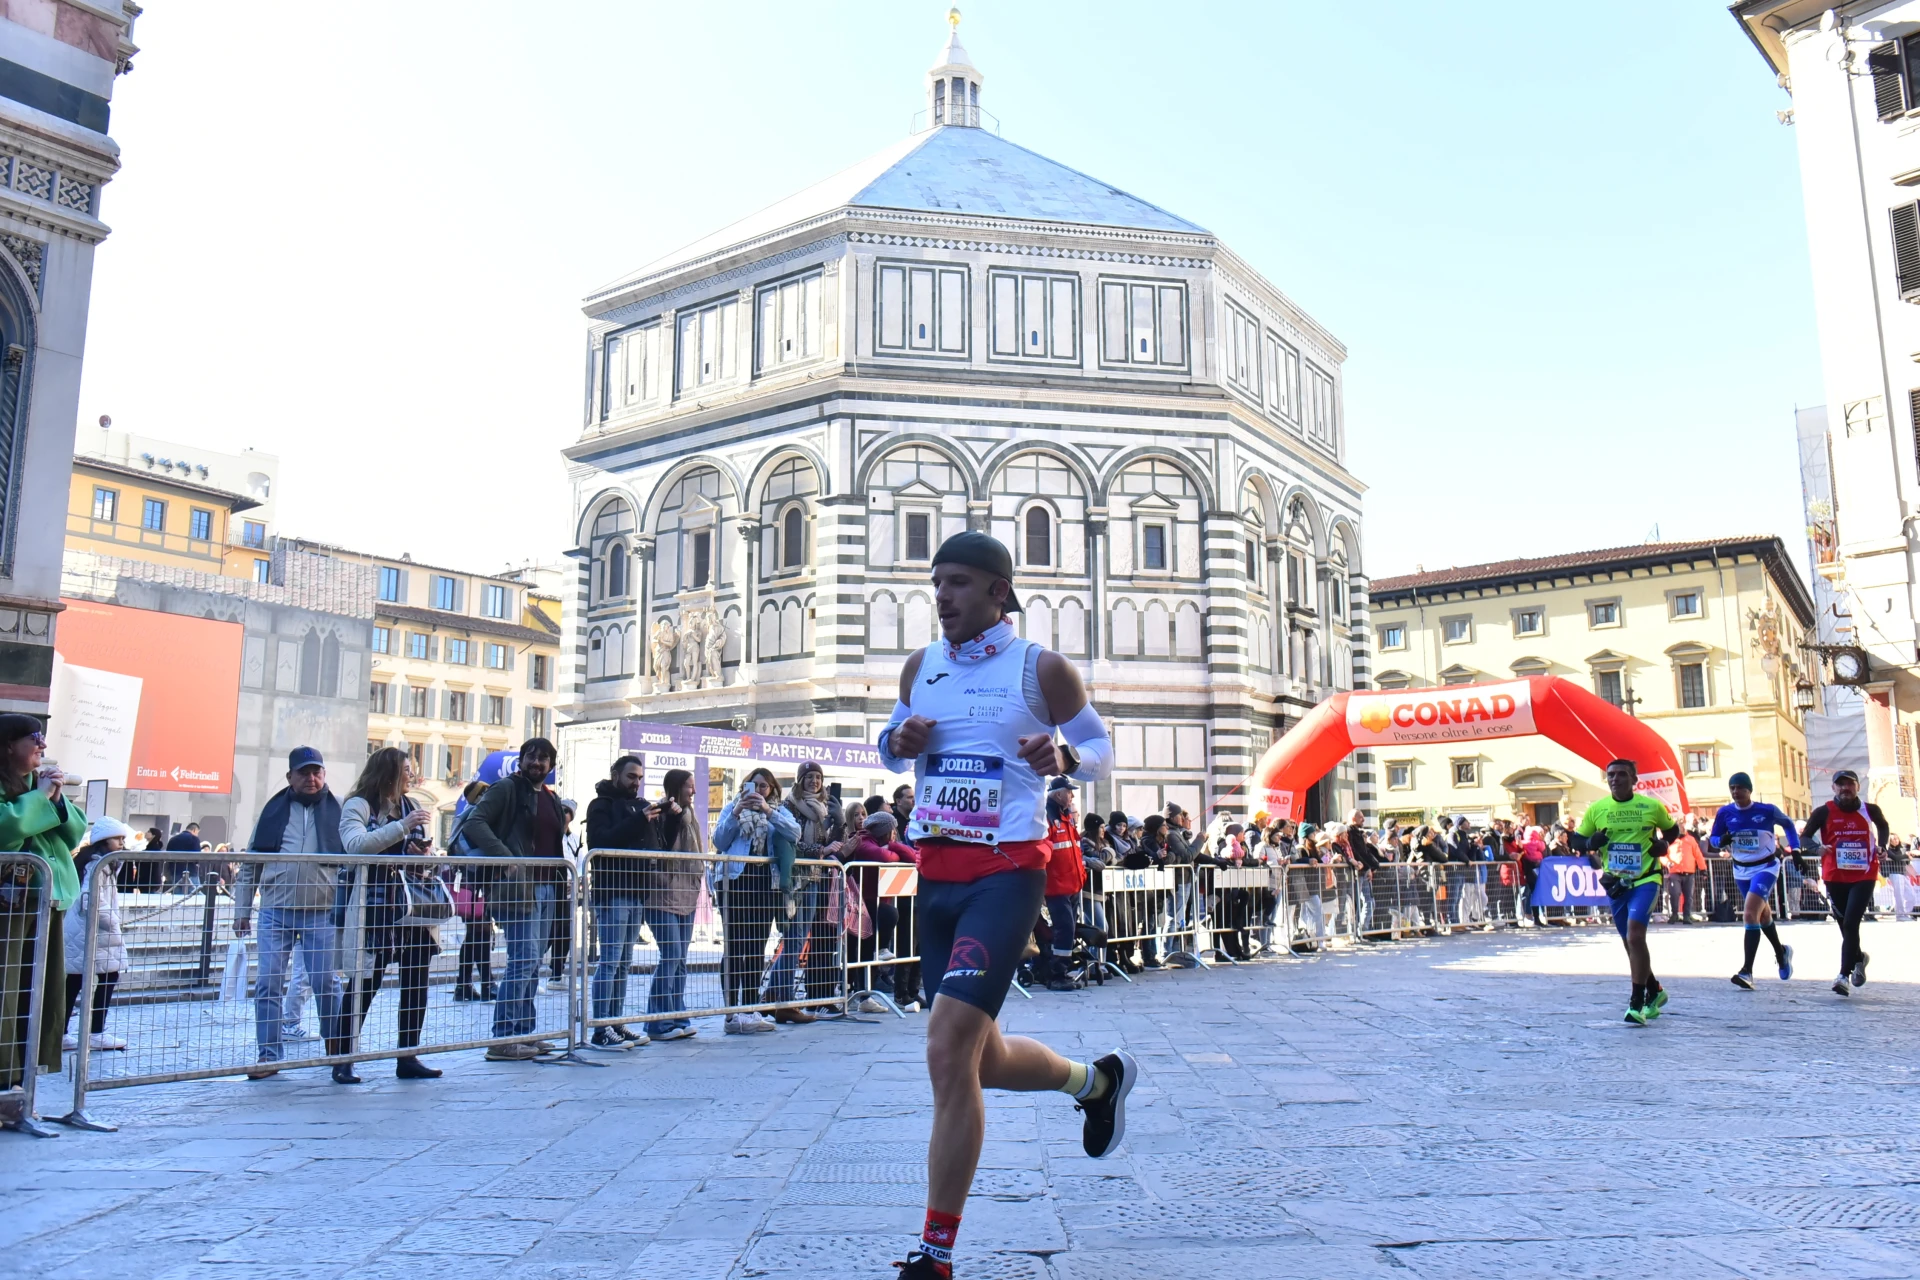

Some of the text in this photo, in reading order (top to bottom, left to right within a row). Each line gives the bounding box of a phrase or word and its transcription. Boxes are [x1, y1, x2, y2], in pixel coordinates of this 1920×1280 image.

[978, 705, 1004, 713] PALAZZO
[1392, 694, 1515, 728] CONAD
[1393, 723, 1513, 741] Persone oltre le cose
[700, 735, 742, 748] FIRENZE
[698, 744, 749, 757] MARATHON
[762, 742, 833, 761] PARTENZA
[136, 766, 220, 781] Entra in Feltrinelli
[1633, 777, 1674, 791] ONAD
[936, 786, 981, 813] 4486
[940, 828, 983, 839] CONAD
[1613, 854, 1634, 866] 1625
[1843, 852, 1861, 860] 3852
[1125, 874, 1146, 889] S.O.S.
